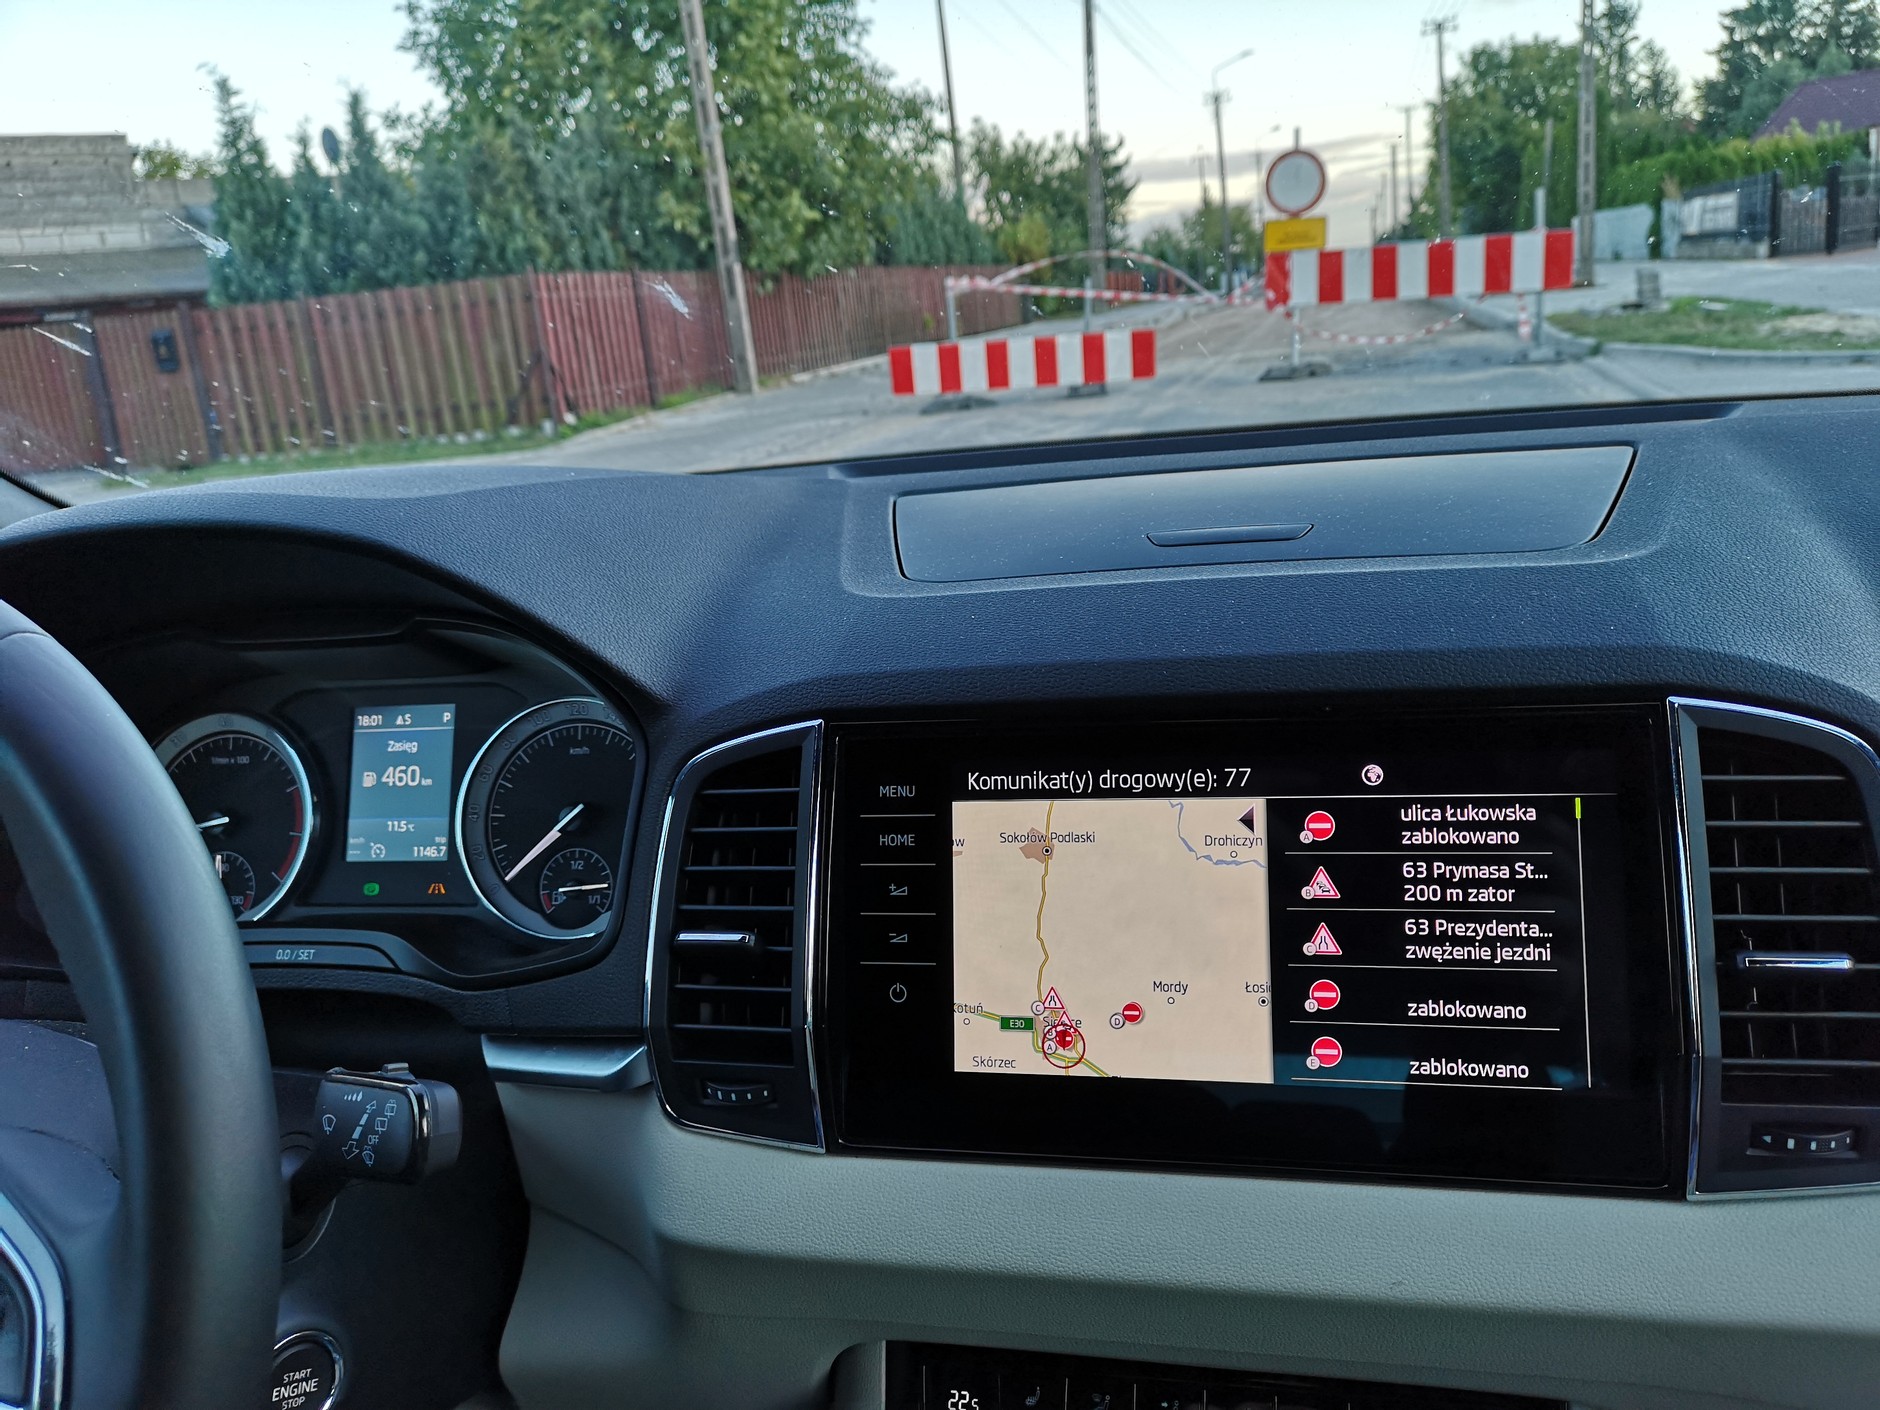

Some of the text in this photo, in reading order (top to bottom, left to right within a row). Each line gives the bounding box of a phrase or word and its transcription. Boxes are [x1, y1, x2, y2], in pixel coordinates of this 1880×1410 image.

[357, 714, 383, 727] 18:01
[443, 711, 452, 723] P
[387, 740, 419, 754] Zasięg
[381, 764, 433, 787] 460 km
[967, 768, 1252, 794] Komunikat(y) drogowy(e): 77
[879, 785, 916, 798] MENU
[1400, 803, 1537, 822] ulica Łukowska
[879, 834, 916, 846] HOME
[999, 831, 1096, 845] Sokołów Podlaski
[1203, 834, 1264, 848] Drohiczyn
[1401, 827, 1520, 846] zablokowano
[413, 845, 447, 858] 1146.7
[571, 860, 584, 870] 1/2
[1402, 861, 1549, 883] 63 Prymasa St...
[1403, 884, 1516, 904] 200 m zator
[1404, 918, 1553, 941] 63 Prezydenta...
[275, 949, 291, 961] 0.0
[298, 949, 316, 961] SET
[1405, 941, 1552, 964] zwężenie jezdni
[1152, 980, 1189, 996] Mordy
[1407, 1000, 1527, 1020] zablokowano
[1009, 1019, 1025, 1029] E30
[972, 1055, 1017, 1069] Skórzec
[1409, 1058, 1530, 1079] zablokowano
[367, 1134, 380, 1145] OFF
[282, 1367, 313, 1384] START
[271, 1377, 319, 1402] ENGINE
[281, 1395, 306, 1410] STOP
